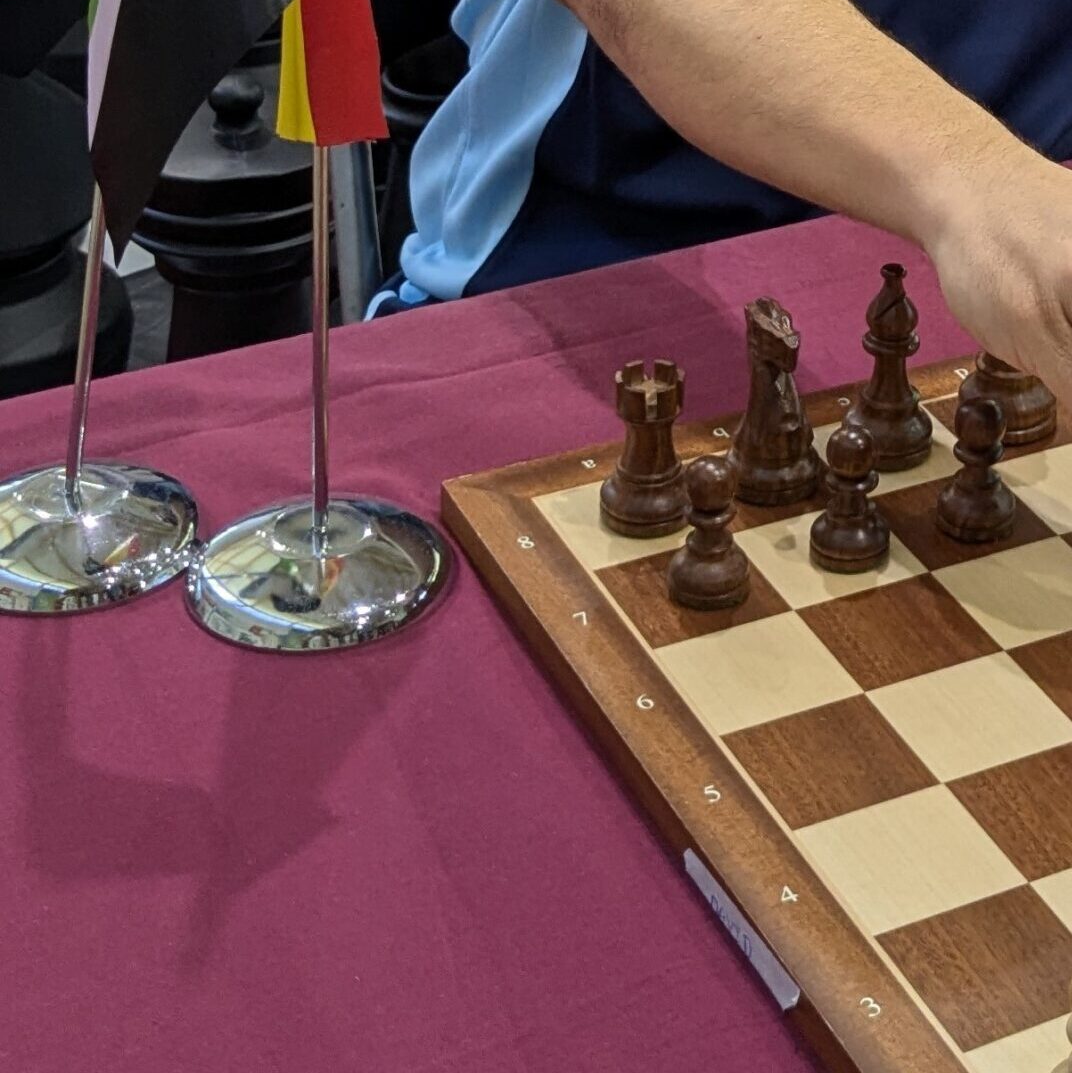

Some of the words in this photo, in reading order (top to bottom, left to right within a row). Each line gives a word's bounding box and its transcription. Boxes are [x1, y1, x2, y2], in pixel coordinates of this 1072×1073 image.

[517, 536, 535, 548] 8
[572, 611, 587, 625] 7
[636, 694, 655, 709] 6
[704, 785, 721, 803] 5
[781, 885, 798, 902] 4
[860, 997, 881, 1017] 3
